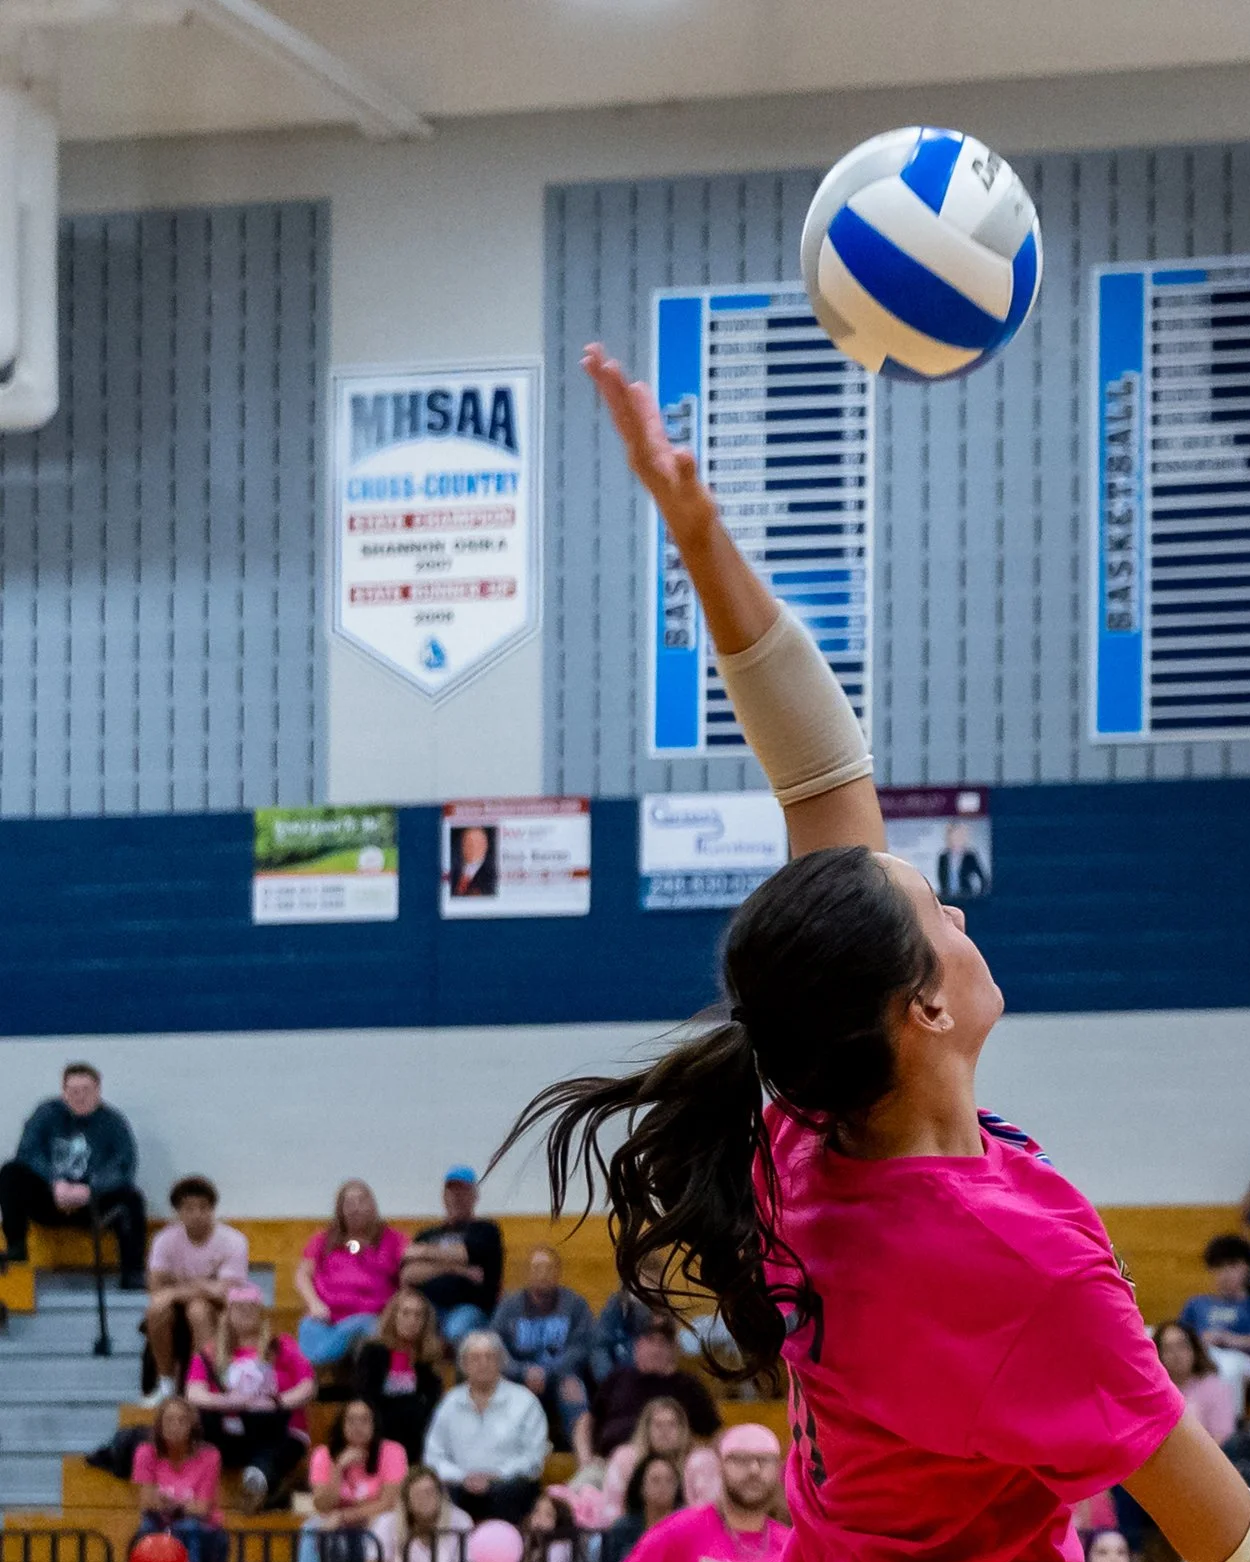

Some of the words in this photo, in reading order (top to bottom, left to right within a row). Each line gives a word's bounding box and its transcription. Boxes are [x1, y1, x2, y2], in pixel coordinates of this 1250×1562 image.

[350, 386, 518, 463] MHSAA
[348, 471, 519, 501] CROSS-COUNTRY
[1106, 380, 1133, 632] BASKETBALL
